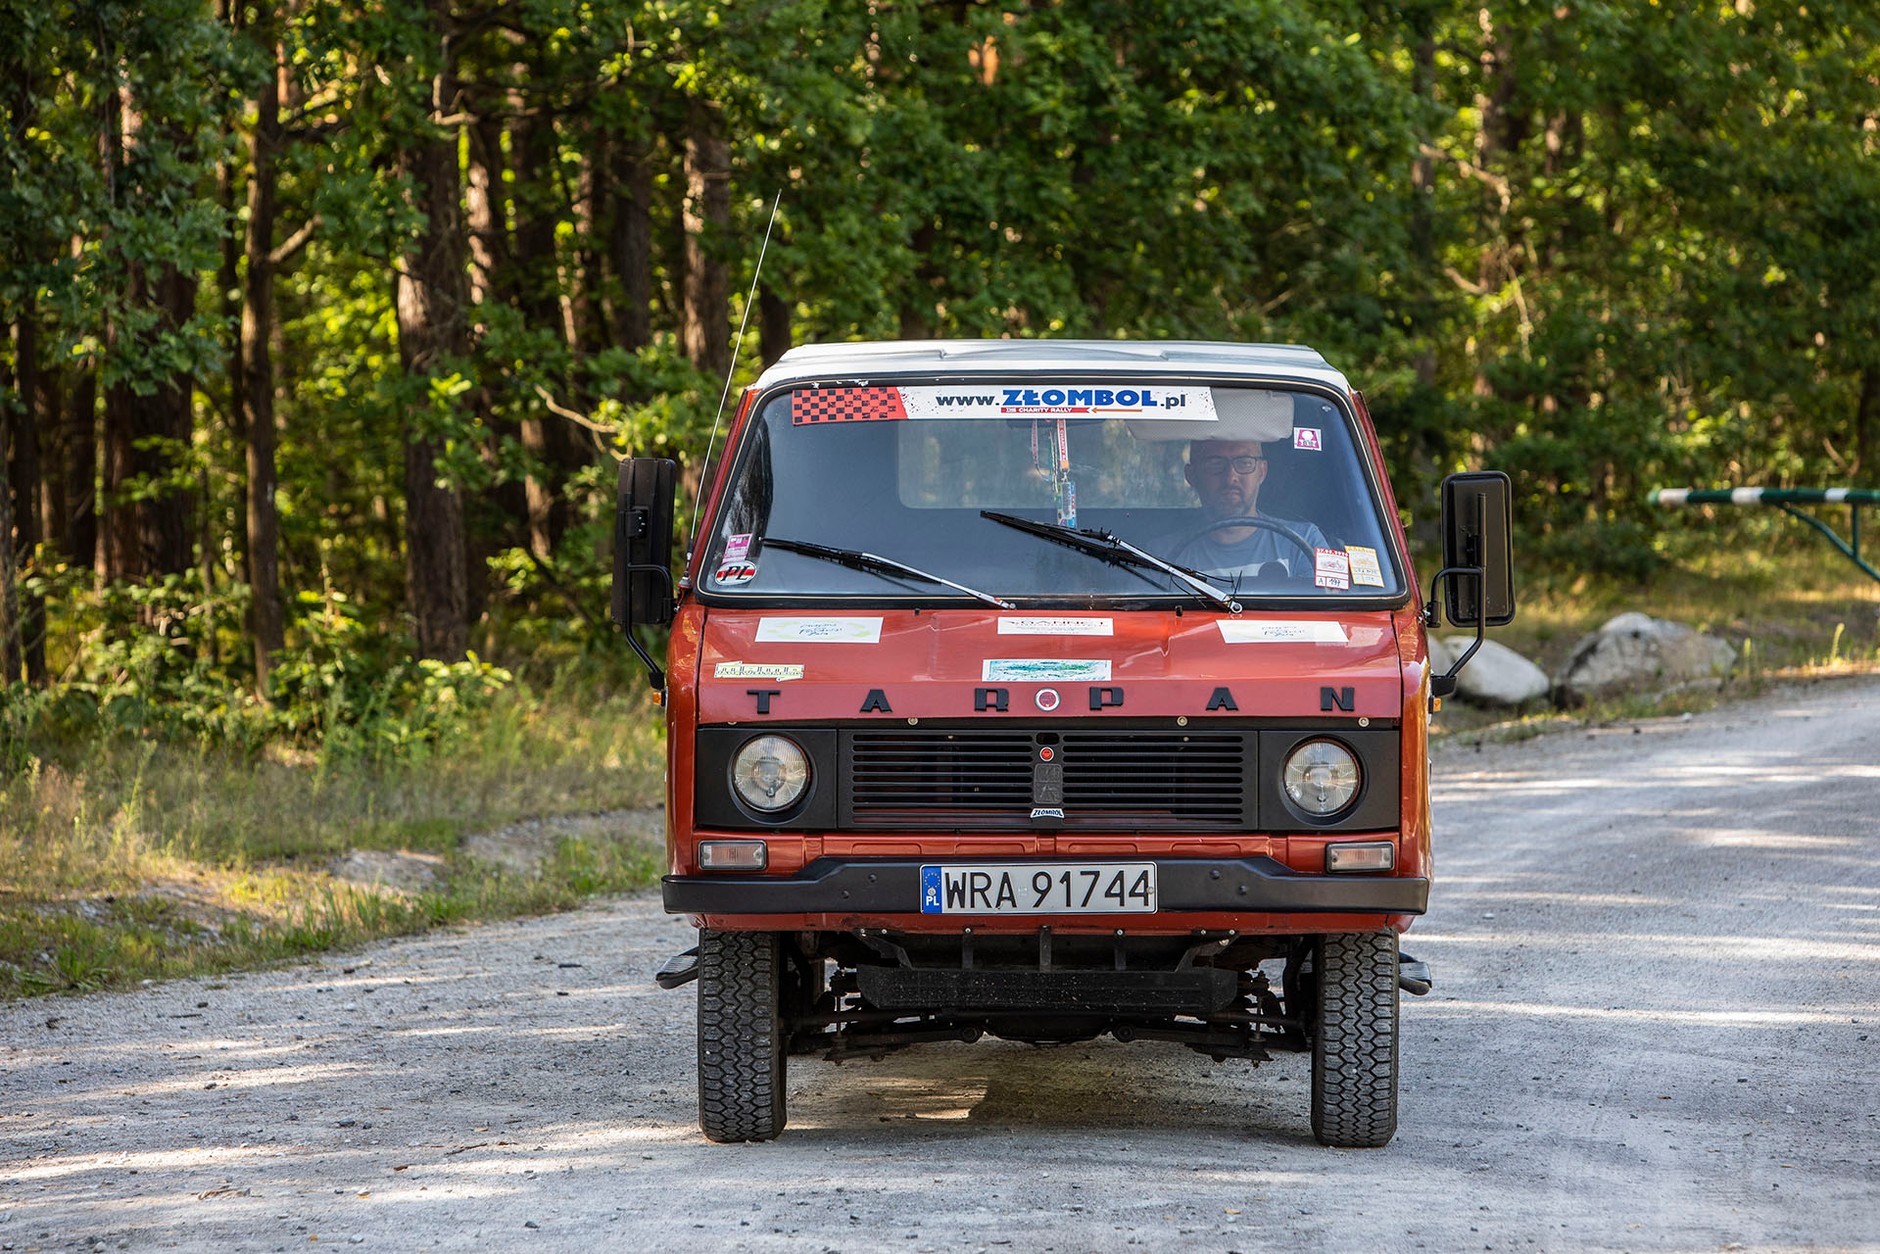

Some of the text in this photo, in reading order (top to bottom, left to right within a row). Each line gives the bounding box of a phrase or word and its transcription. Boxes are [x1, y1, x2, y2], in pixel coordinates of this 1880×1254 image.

[936, 389, 1187, 409] www.ZŁOMBOL.pl
[720, 565, 751, 582] PL
[746, 687, 1356, 715] TARPAN
[944, 869, 1150, 909] WRA 91744
[925, 895, 940, 907] PL
